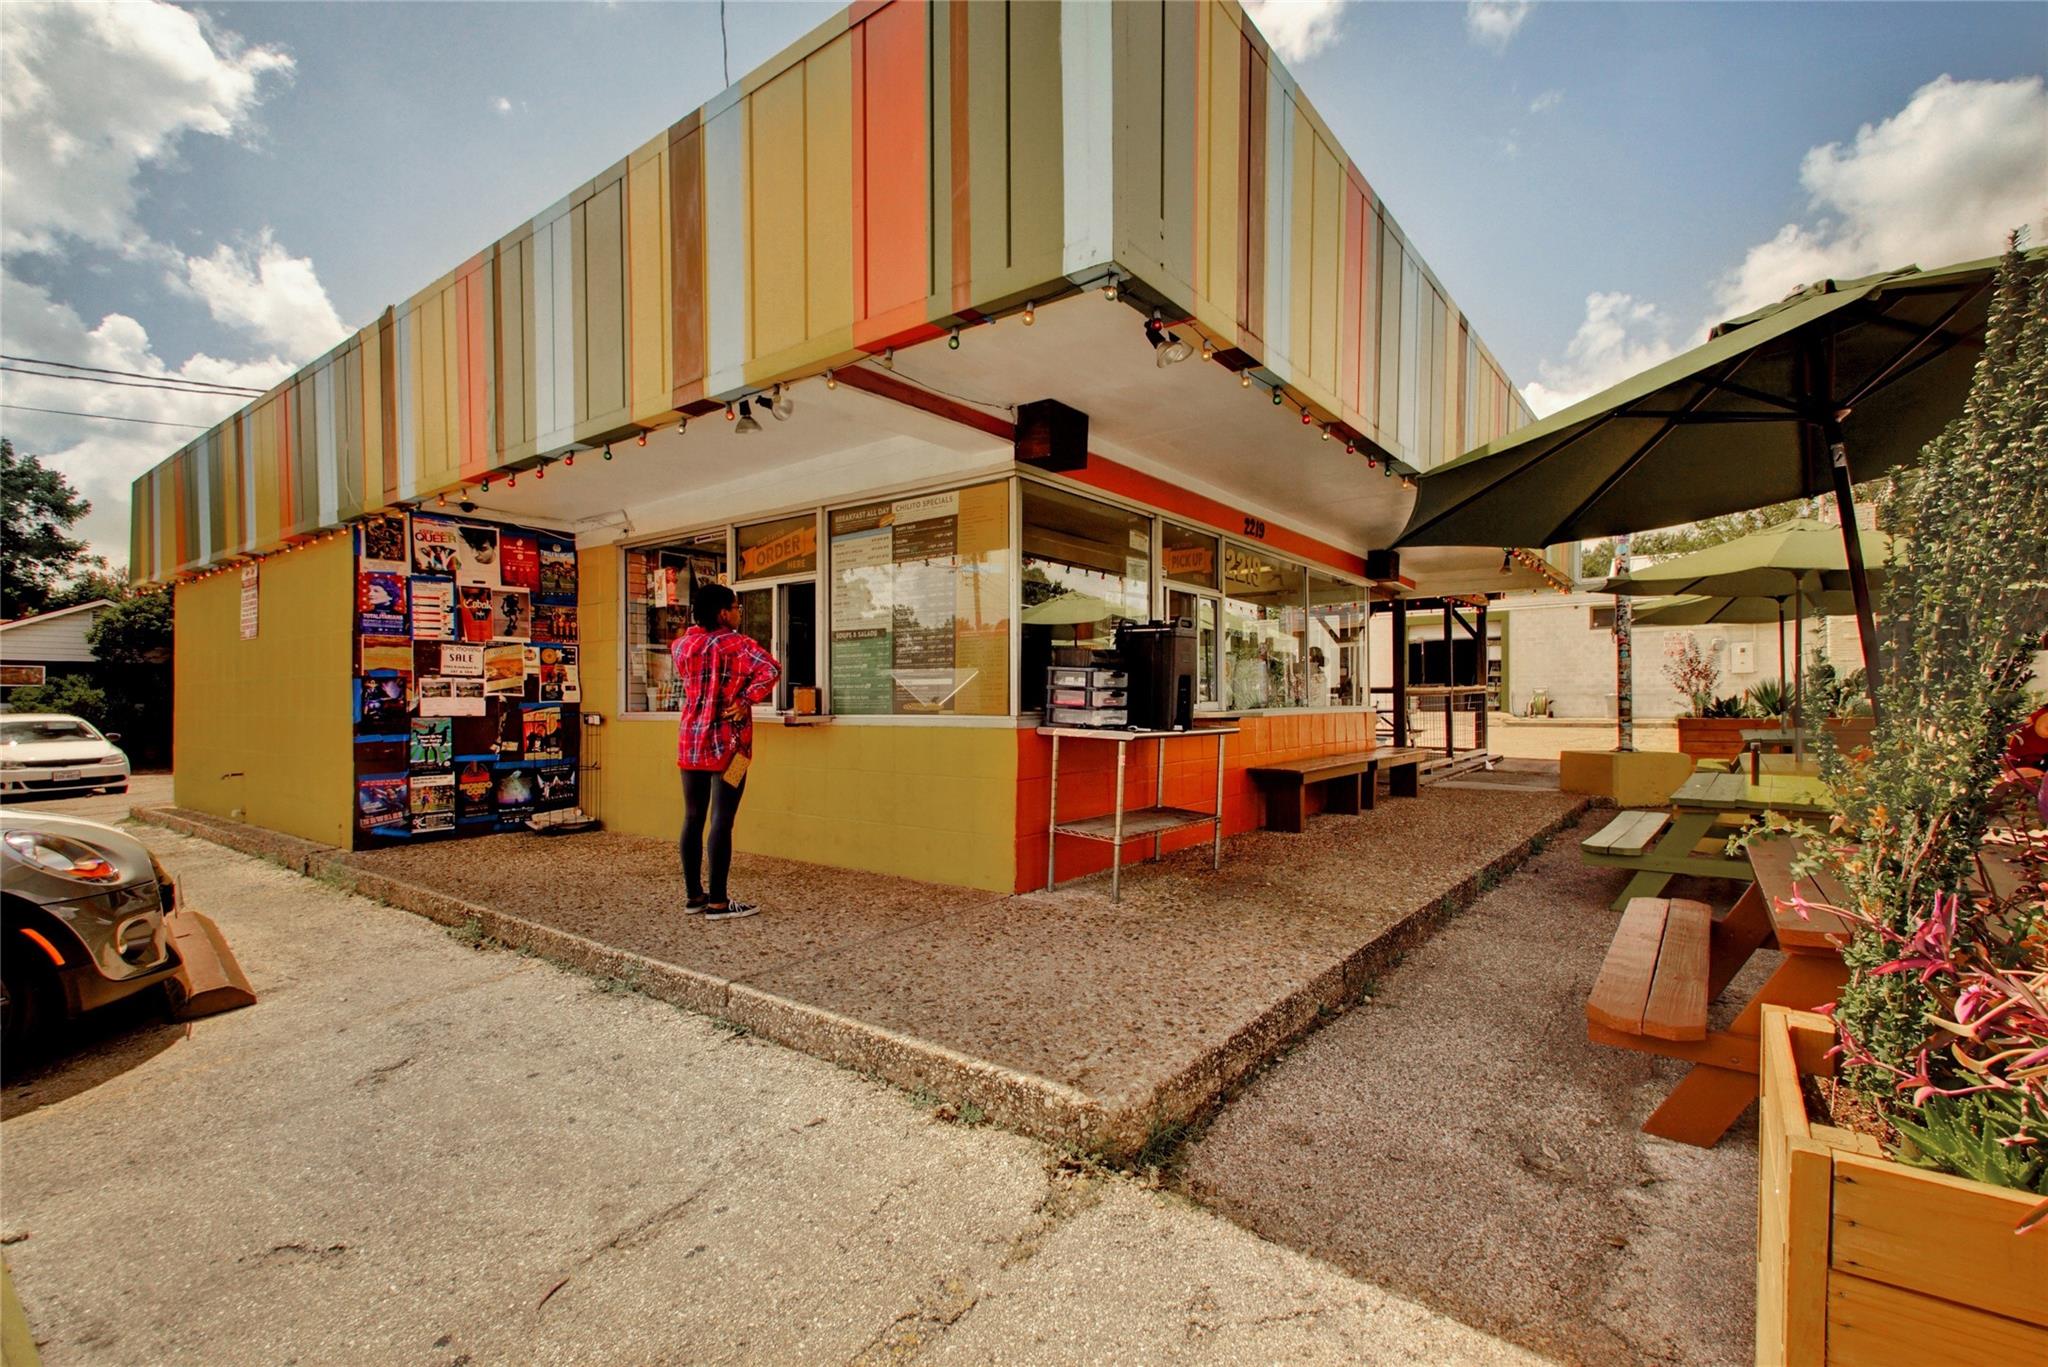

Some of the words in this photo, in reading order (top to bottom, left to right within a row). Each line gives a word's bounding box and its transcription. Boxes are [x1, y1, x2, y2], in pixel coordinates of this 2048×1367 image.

[895, 501, 921, 512] CHILITO
[922, 496, 953, 507] SPECIALS
[835, 511, 866, 523] BREAKFAST
[1244, 517, 1265, 539] 2219
[415, 532, 457, 543] QUEER
[756, 535, 801, 566] ORDER
[787, 559, 806, 569] HERE
[1171, 553, 1191, 568] PICK
[449, 653, 473, 662] SALE
